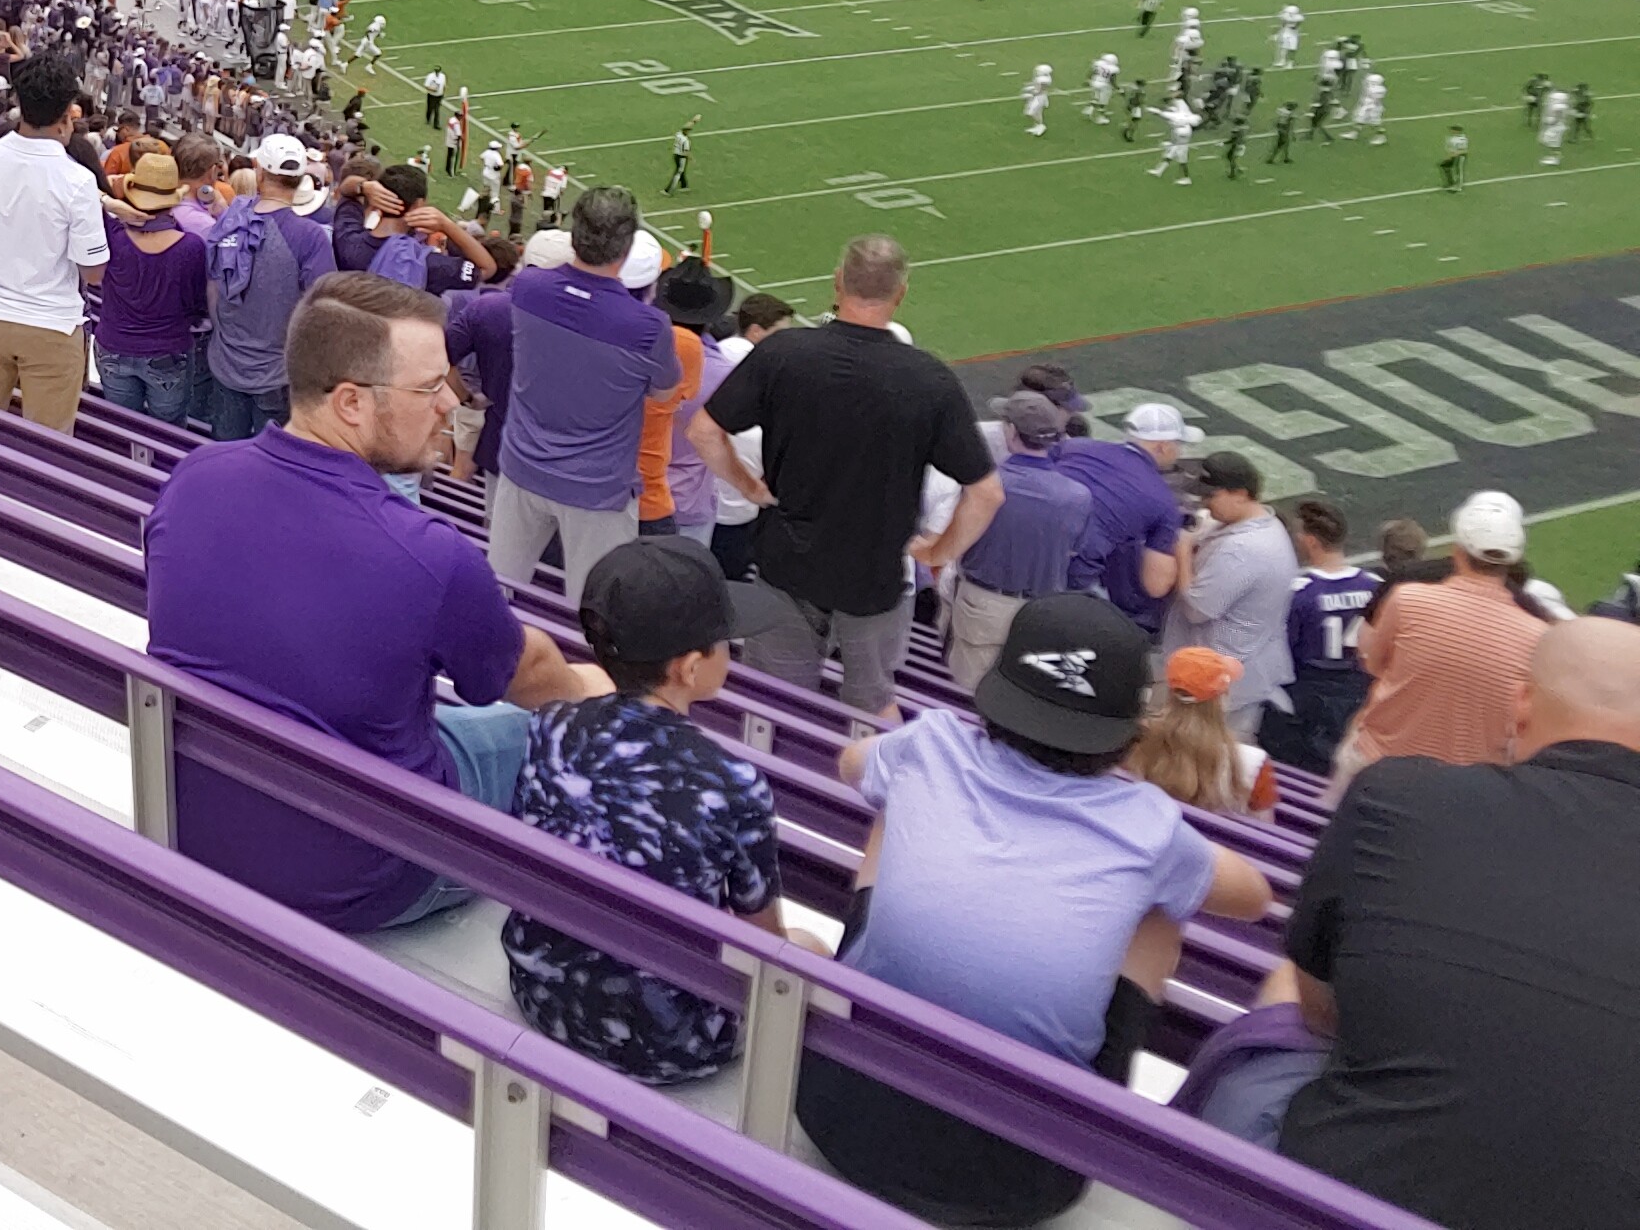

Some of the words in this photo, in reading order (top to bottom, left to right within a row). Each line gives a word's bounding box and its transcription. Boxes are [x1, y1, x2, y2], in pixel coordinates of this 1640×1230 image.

[602, 59, 704, 98] 20
[824, 170, 934, 210] 10
[1075, 293, 1640, 503] ROGS
